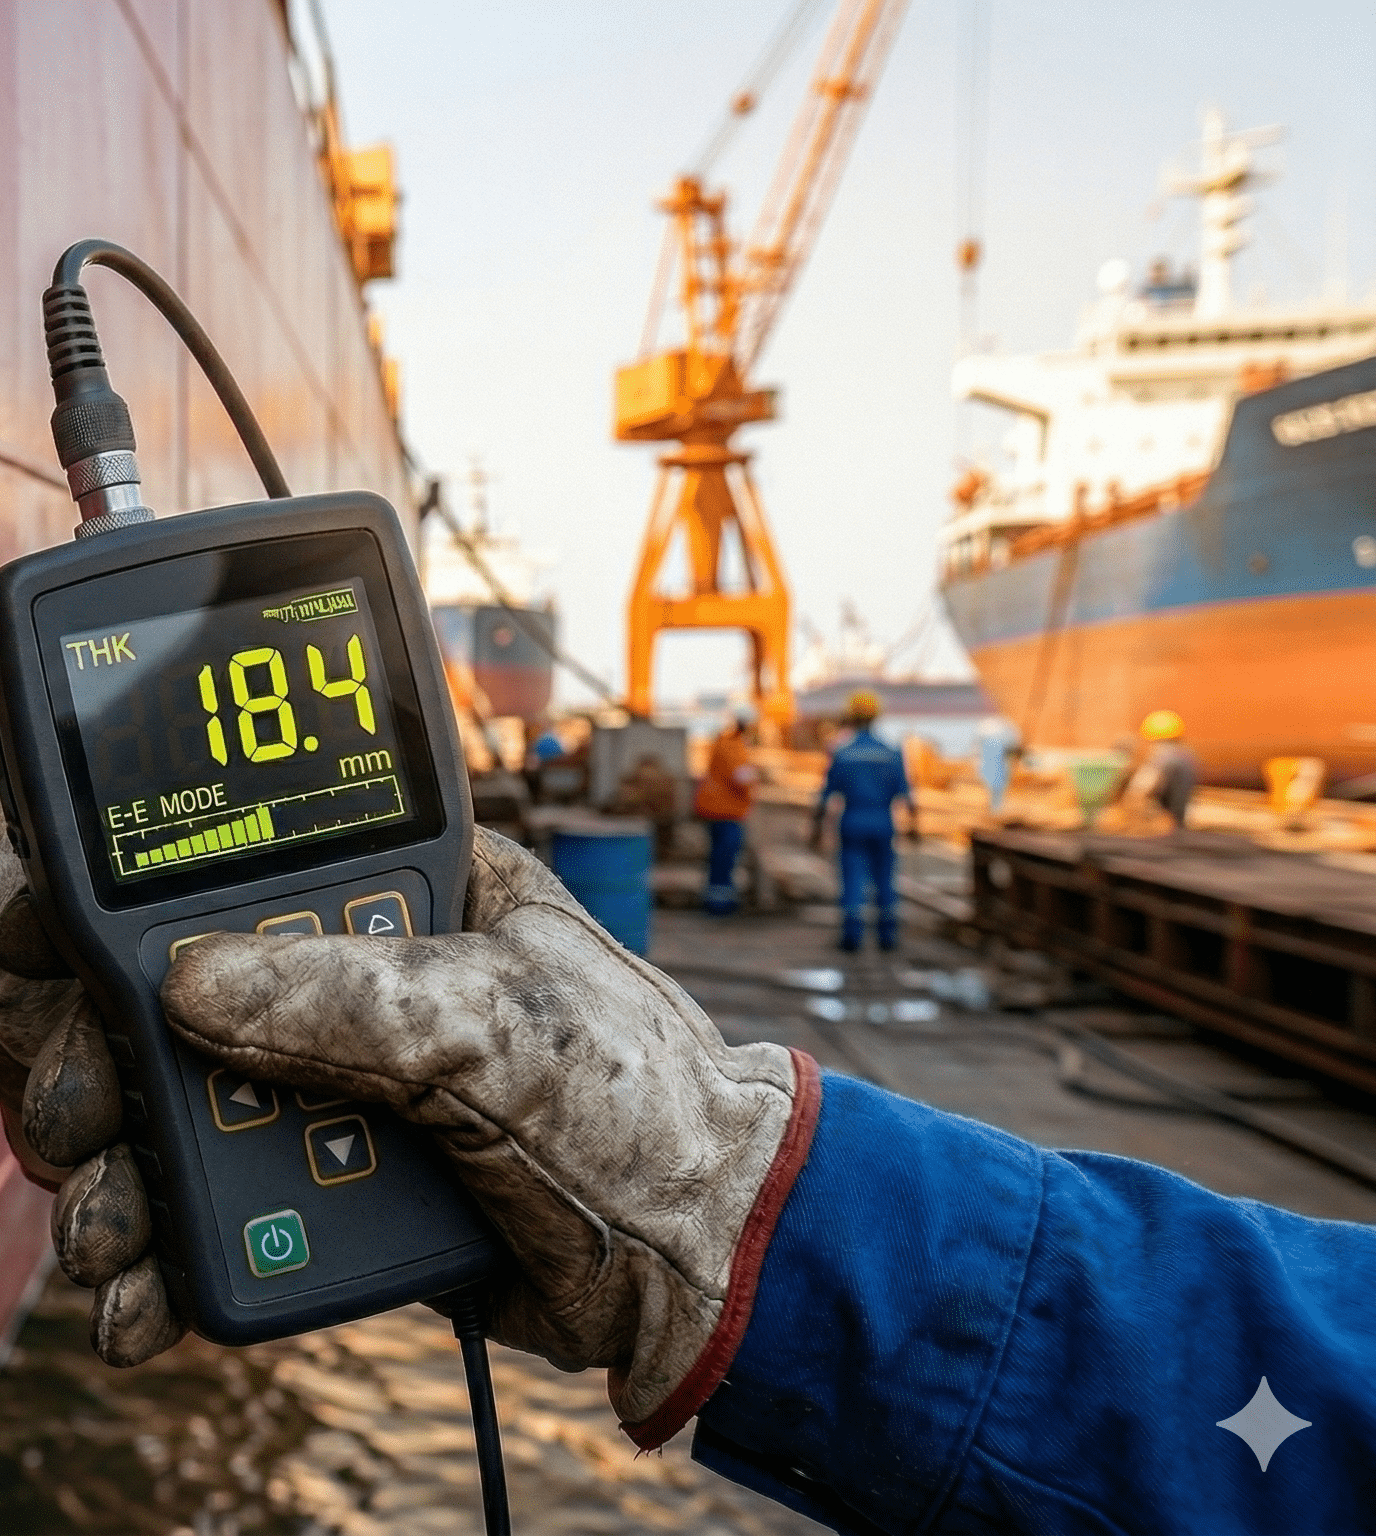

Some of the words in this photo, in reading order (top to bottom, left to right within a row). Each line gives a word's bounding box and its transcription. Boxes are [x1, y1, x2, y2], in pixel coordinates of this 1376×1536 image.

[65, 632, 136, 671] THK
[198, 633, 377, 767] 18.4
[338, 749, 392, 779] mm
[107, 799, 149, 828] E-E
[160, 783, 227, 818] MODE
